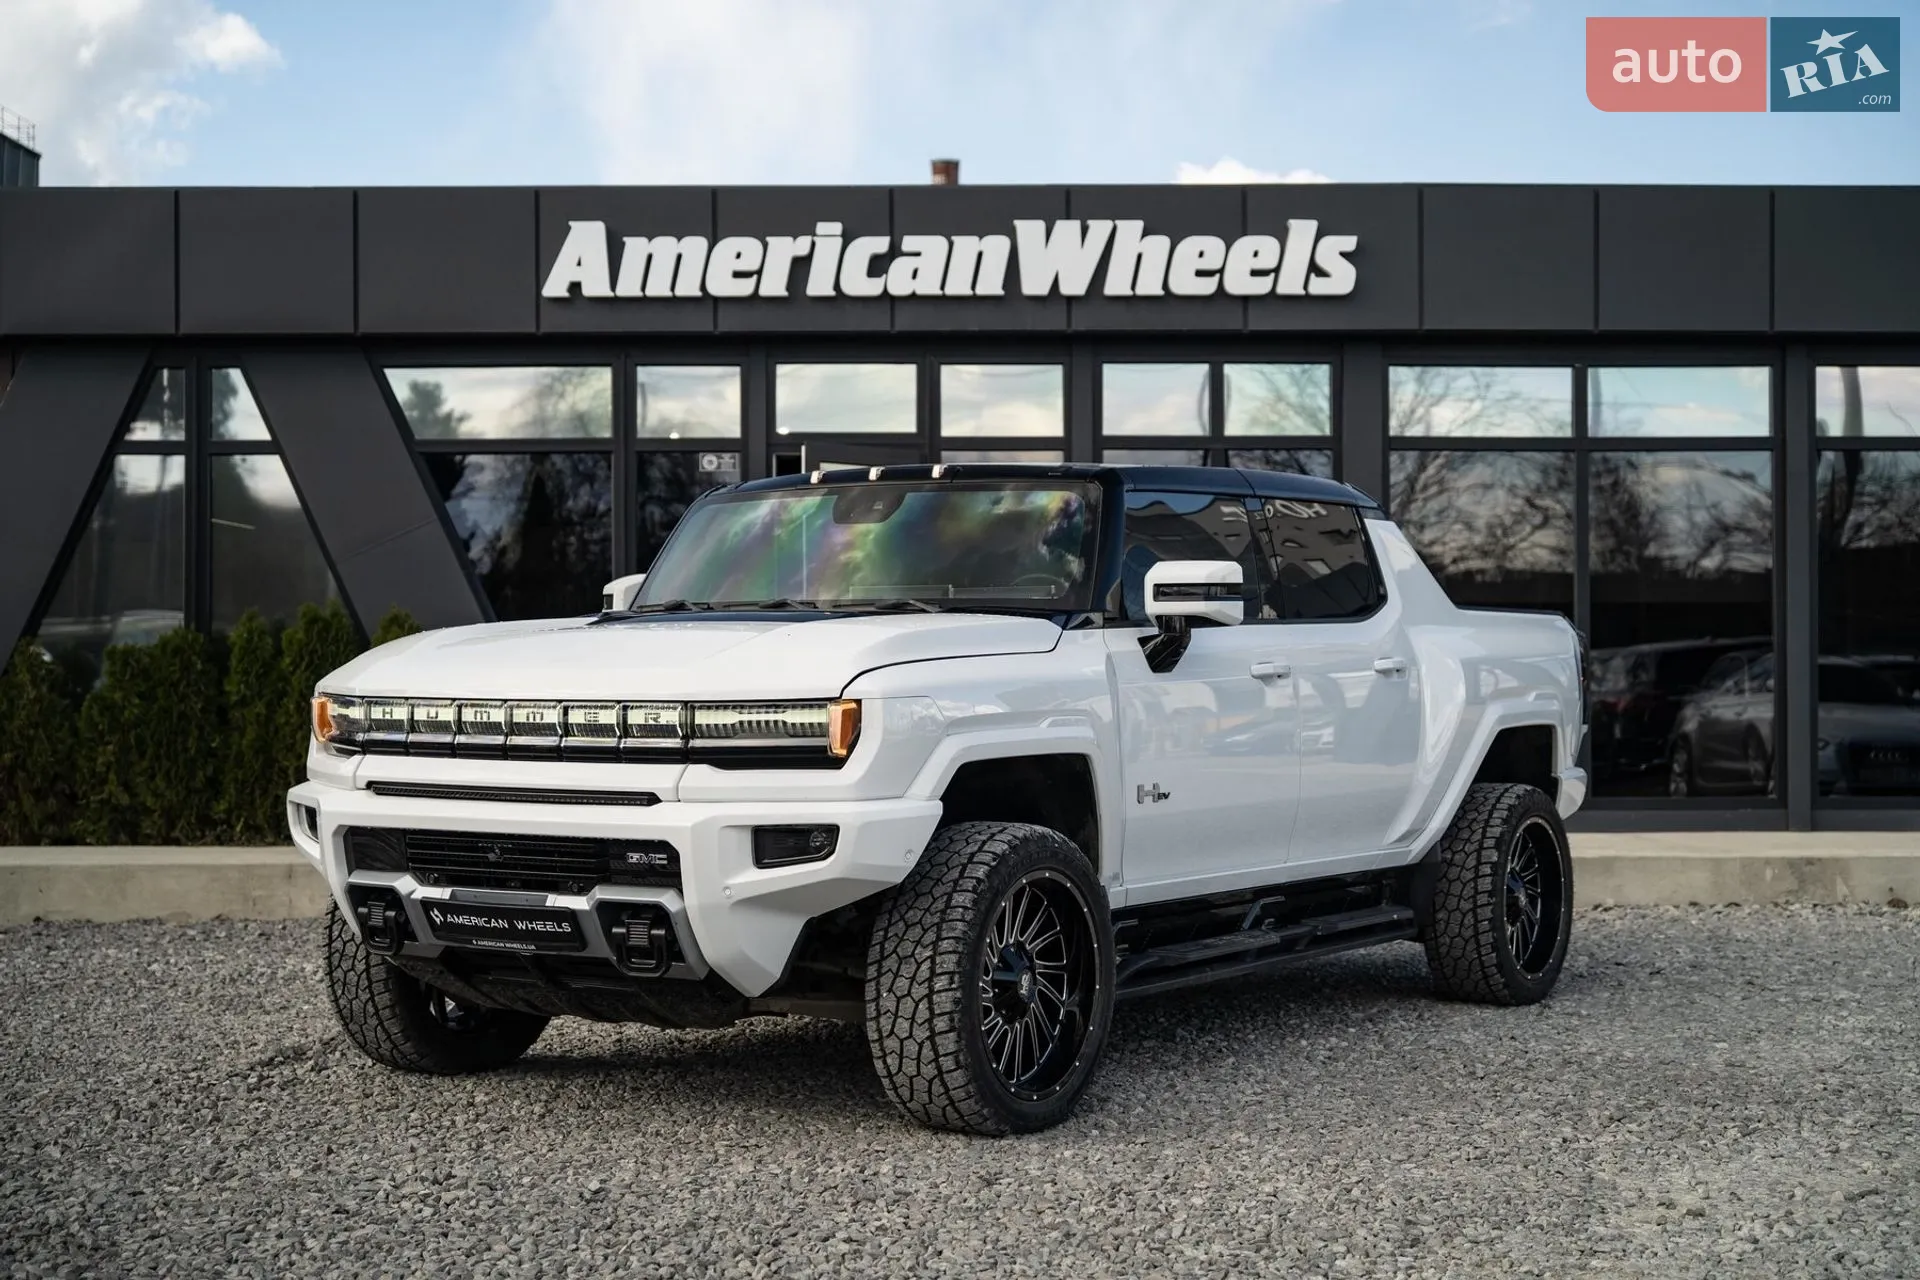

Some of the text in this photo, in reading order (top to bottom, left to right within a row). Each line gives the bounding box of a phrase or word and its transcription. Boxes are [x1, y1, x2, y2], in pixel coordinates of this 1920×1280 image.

[626, 852, 668, 864] GMC
[446, 914, 572, 933] AMERICAN WHEELS
[477, 939, 504, 947] AMERICAN
